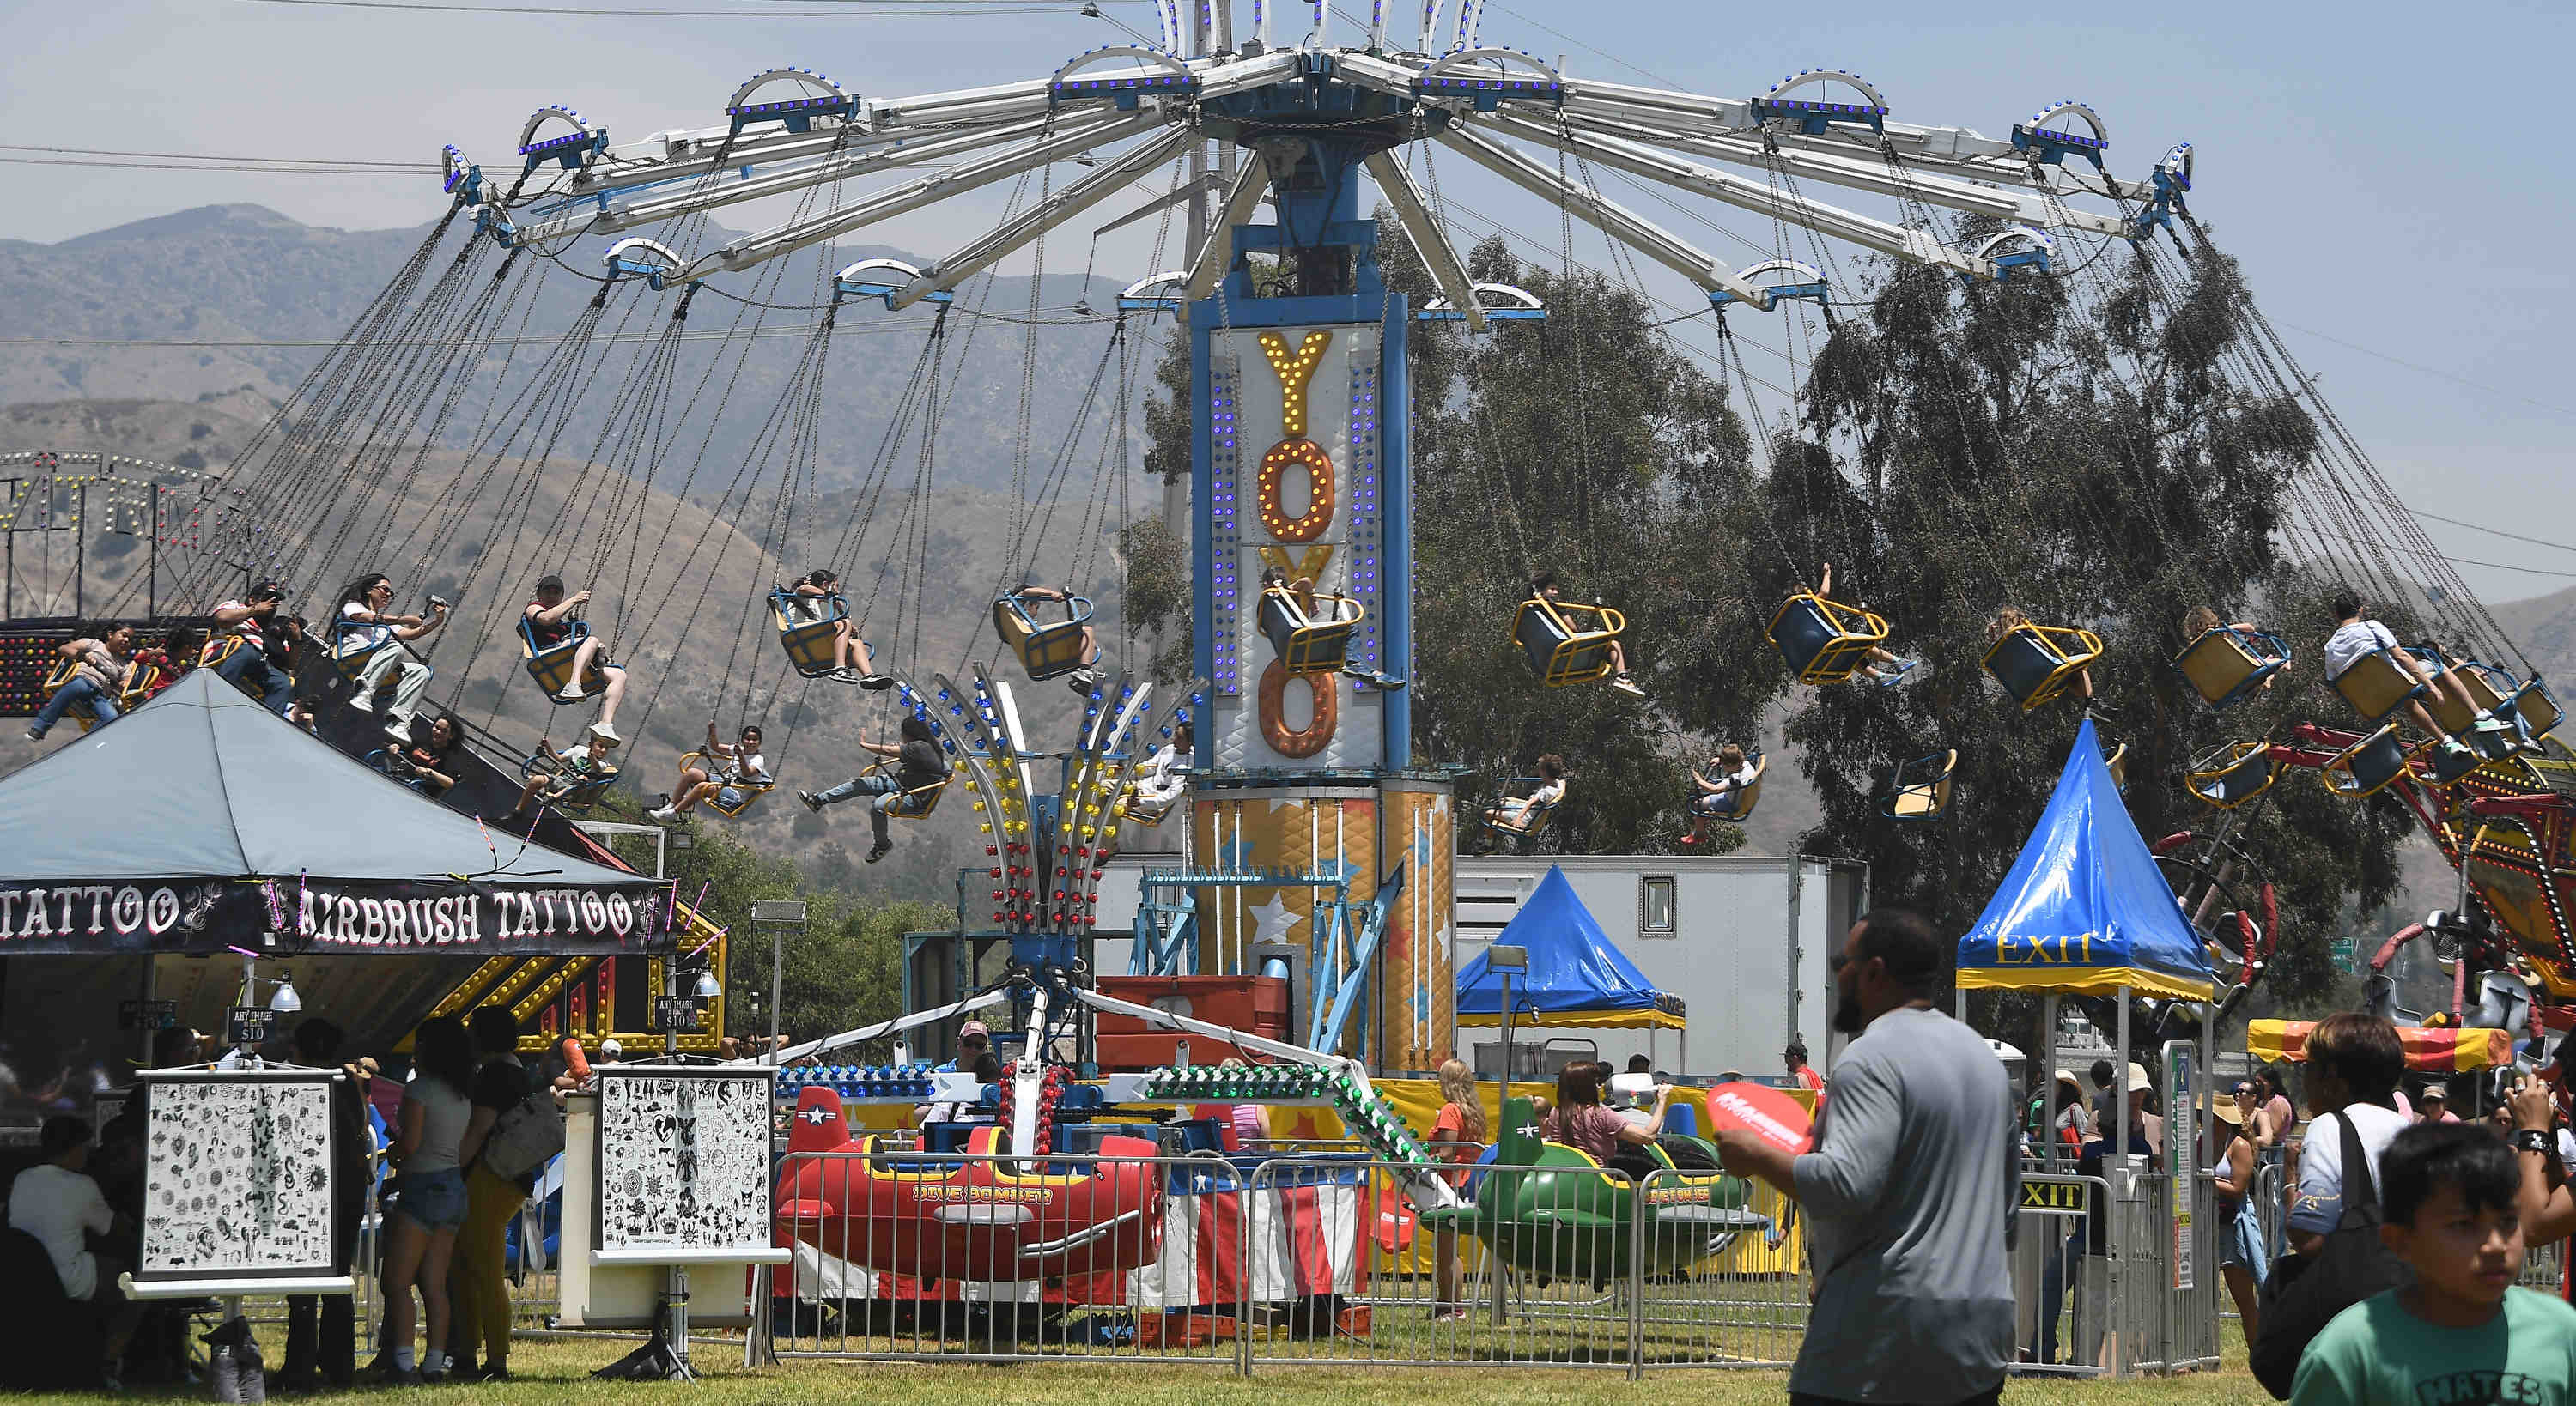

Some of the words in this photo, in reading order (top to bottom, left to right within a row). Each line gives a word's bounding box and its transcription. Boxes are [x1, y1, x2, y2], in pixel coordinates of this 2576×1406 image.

[0, 885, 179, 939] TATTOO
[298, 888, 482, 946] AIRBRUSH
[492, 889, 634, 936] TATTOO
[1995, 932, 2092, 963] EXIT
[659, 998, 673, 1009] ANY
[674, 1000, 693, 1009] IMAGE
[234, 1010, 249, 1021] ANY
[250, 1011, 273, 1021] IMAGE
[666, 1015, 685, 1027] $10
[242, 1028, 264, 1039] $10
[913, 1185, 963, 1202] DIVE
[964, 1185, 1054, 1204] BOMBER
[2022, 1183, 2080, 1207] XIT
